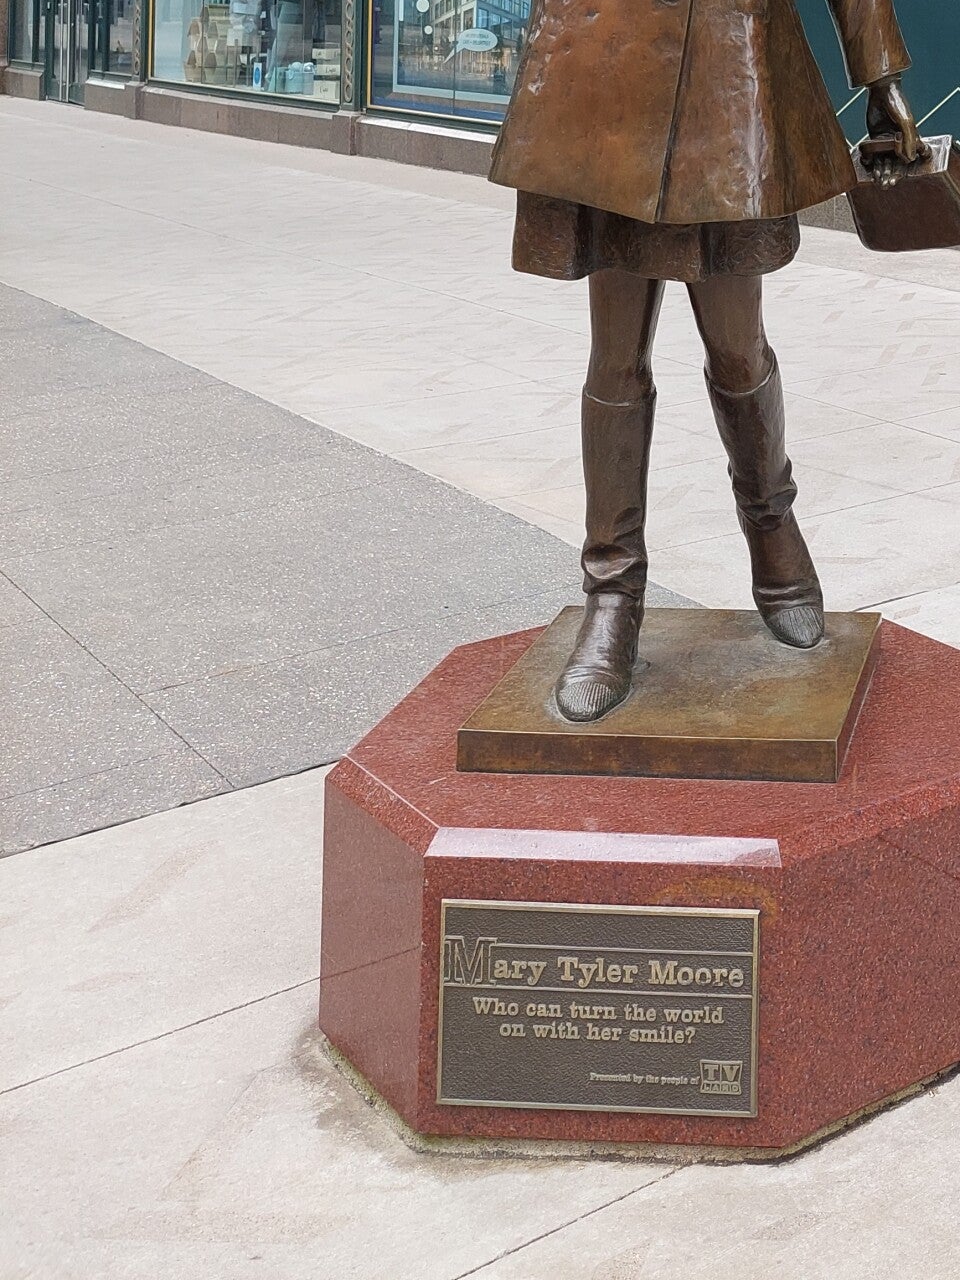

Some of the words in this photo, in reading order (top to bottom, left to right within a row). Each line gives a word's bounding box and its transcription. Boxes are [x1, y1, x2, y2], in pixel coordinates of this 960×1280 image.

[443, 935, 547, 987] Mary
[557, 956, 639, 988] Tyler
[648, 960, 745, 988] Moore
[473, 996, 519, 1017] Who
[525, 1003, 563, 1018] can
[569, 1002, 618, 1020] turn
[623, 1004, 657, 1022] the
[663, 1006, 725, 1024] world
[499, 1023, 526, 1037] on
[532, 1019, 581, 1039] with
[586, 1022, 623, 1041] her
[628, 1025, 696, 1044] smile?
[589, 1072, 632, 1082] Presented
[633, 1073, 644, 1084] by
[645, 1074, 659, 1084] the
[660, 1076, 688, 1086] people
[689, 1075, 701, 1085] of
[703, 1064, 740, 1082] TV
[703, 1084, 740, 1093] LAND
